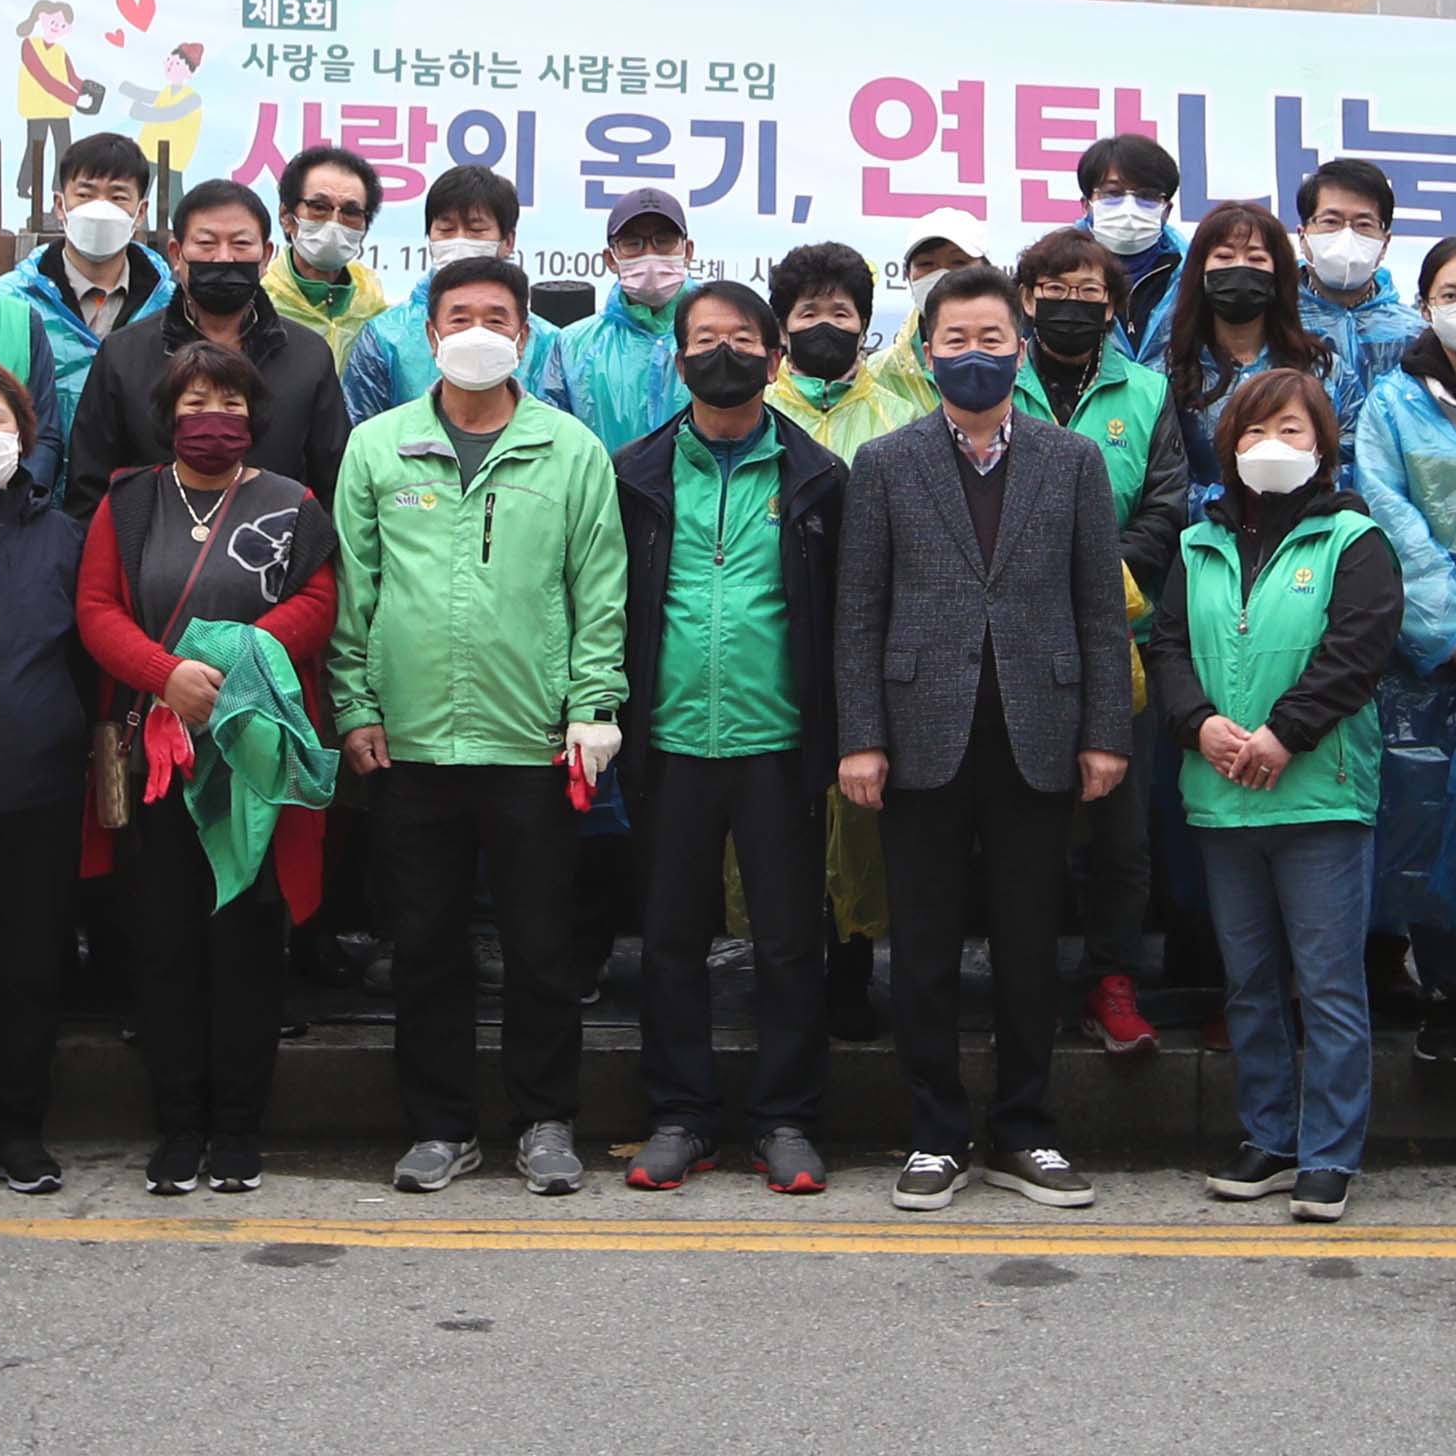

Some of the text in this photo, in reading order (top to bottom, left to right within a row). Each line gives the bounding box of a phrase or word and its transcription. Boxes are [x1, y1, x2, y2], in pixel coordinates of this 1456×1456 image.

[242, 43, 776, 100] 사랑을 나눔하는 사람들의 모임
[533, 251, 607, 279] 10:00
